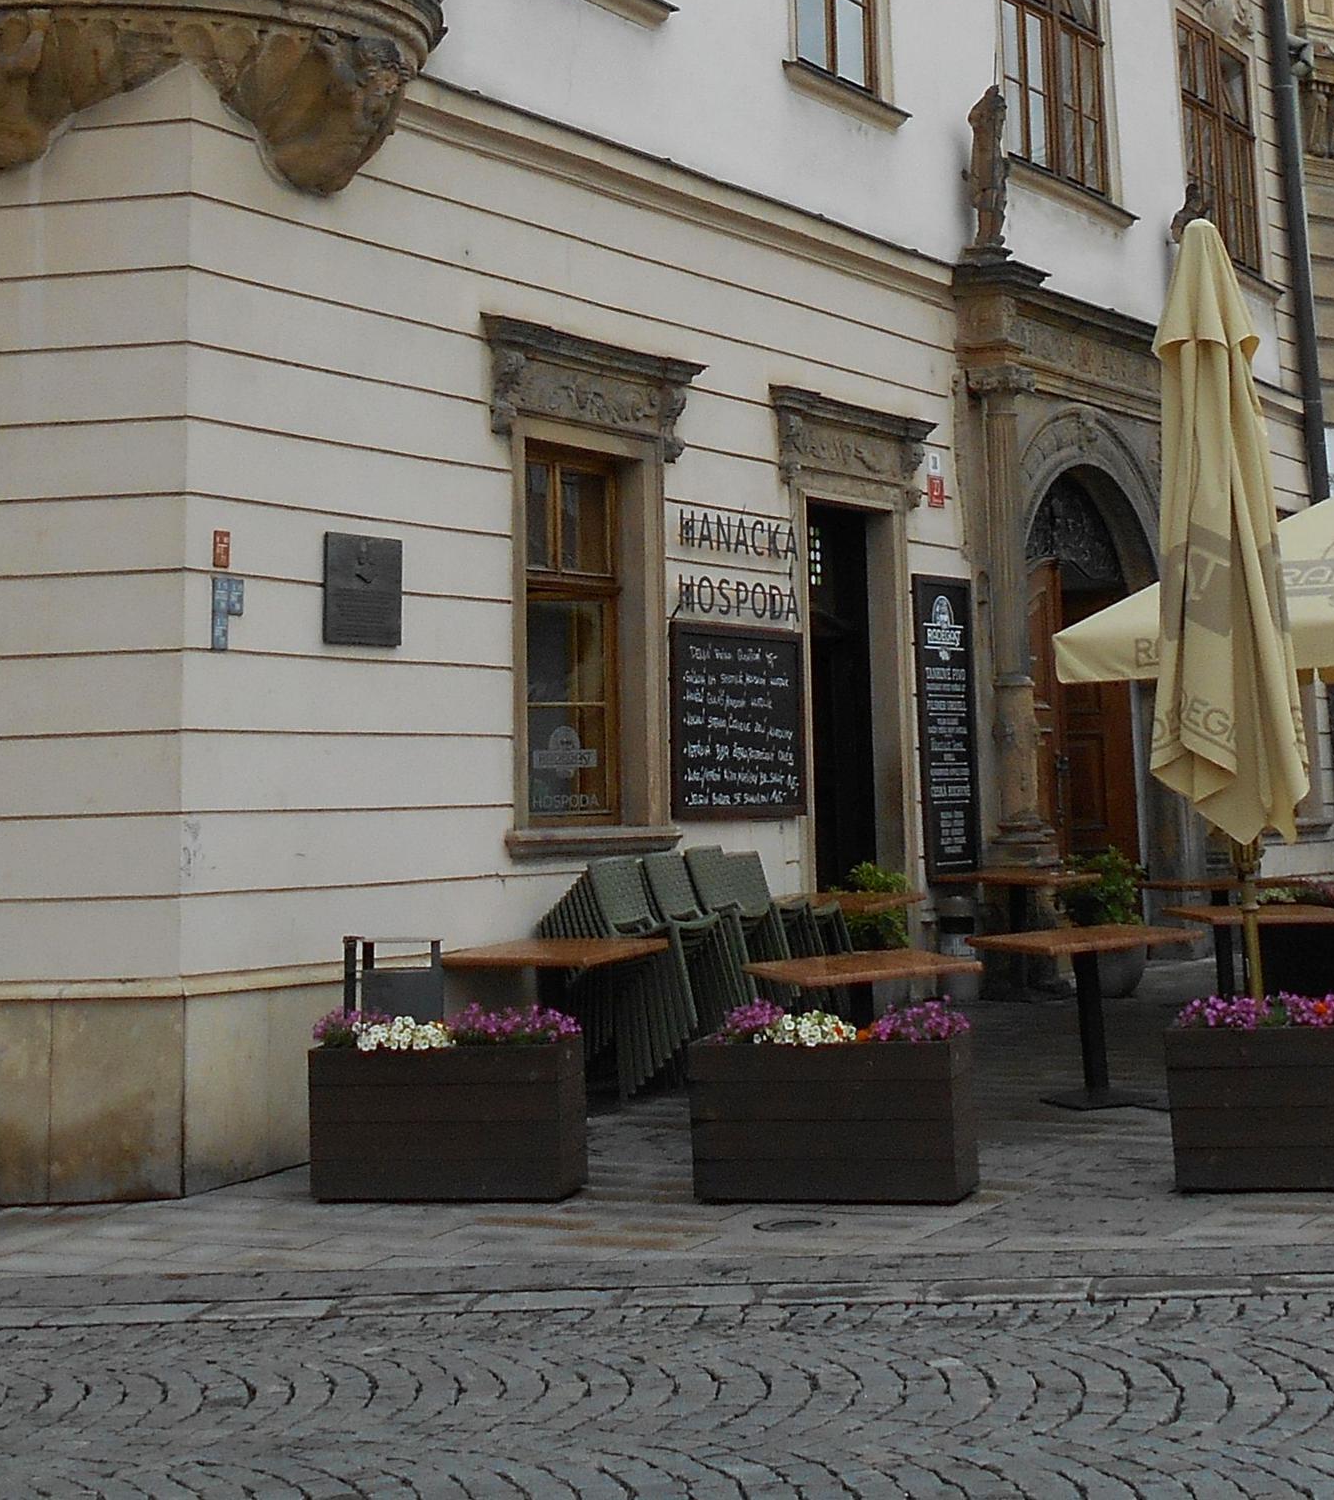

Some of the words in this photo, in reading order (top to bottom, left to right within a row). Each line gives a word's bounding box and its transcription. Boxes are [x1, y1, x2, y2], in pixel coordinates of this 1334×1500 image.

[679, 573, 799, 622] HOSPODA
[927, 628, 962, 647] RADEGAST
[532, 793, 600, 809] HOSPODA
